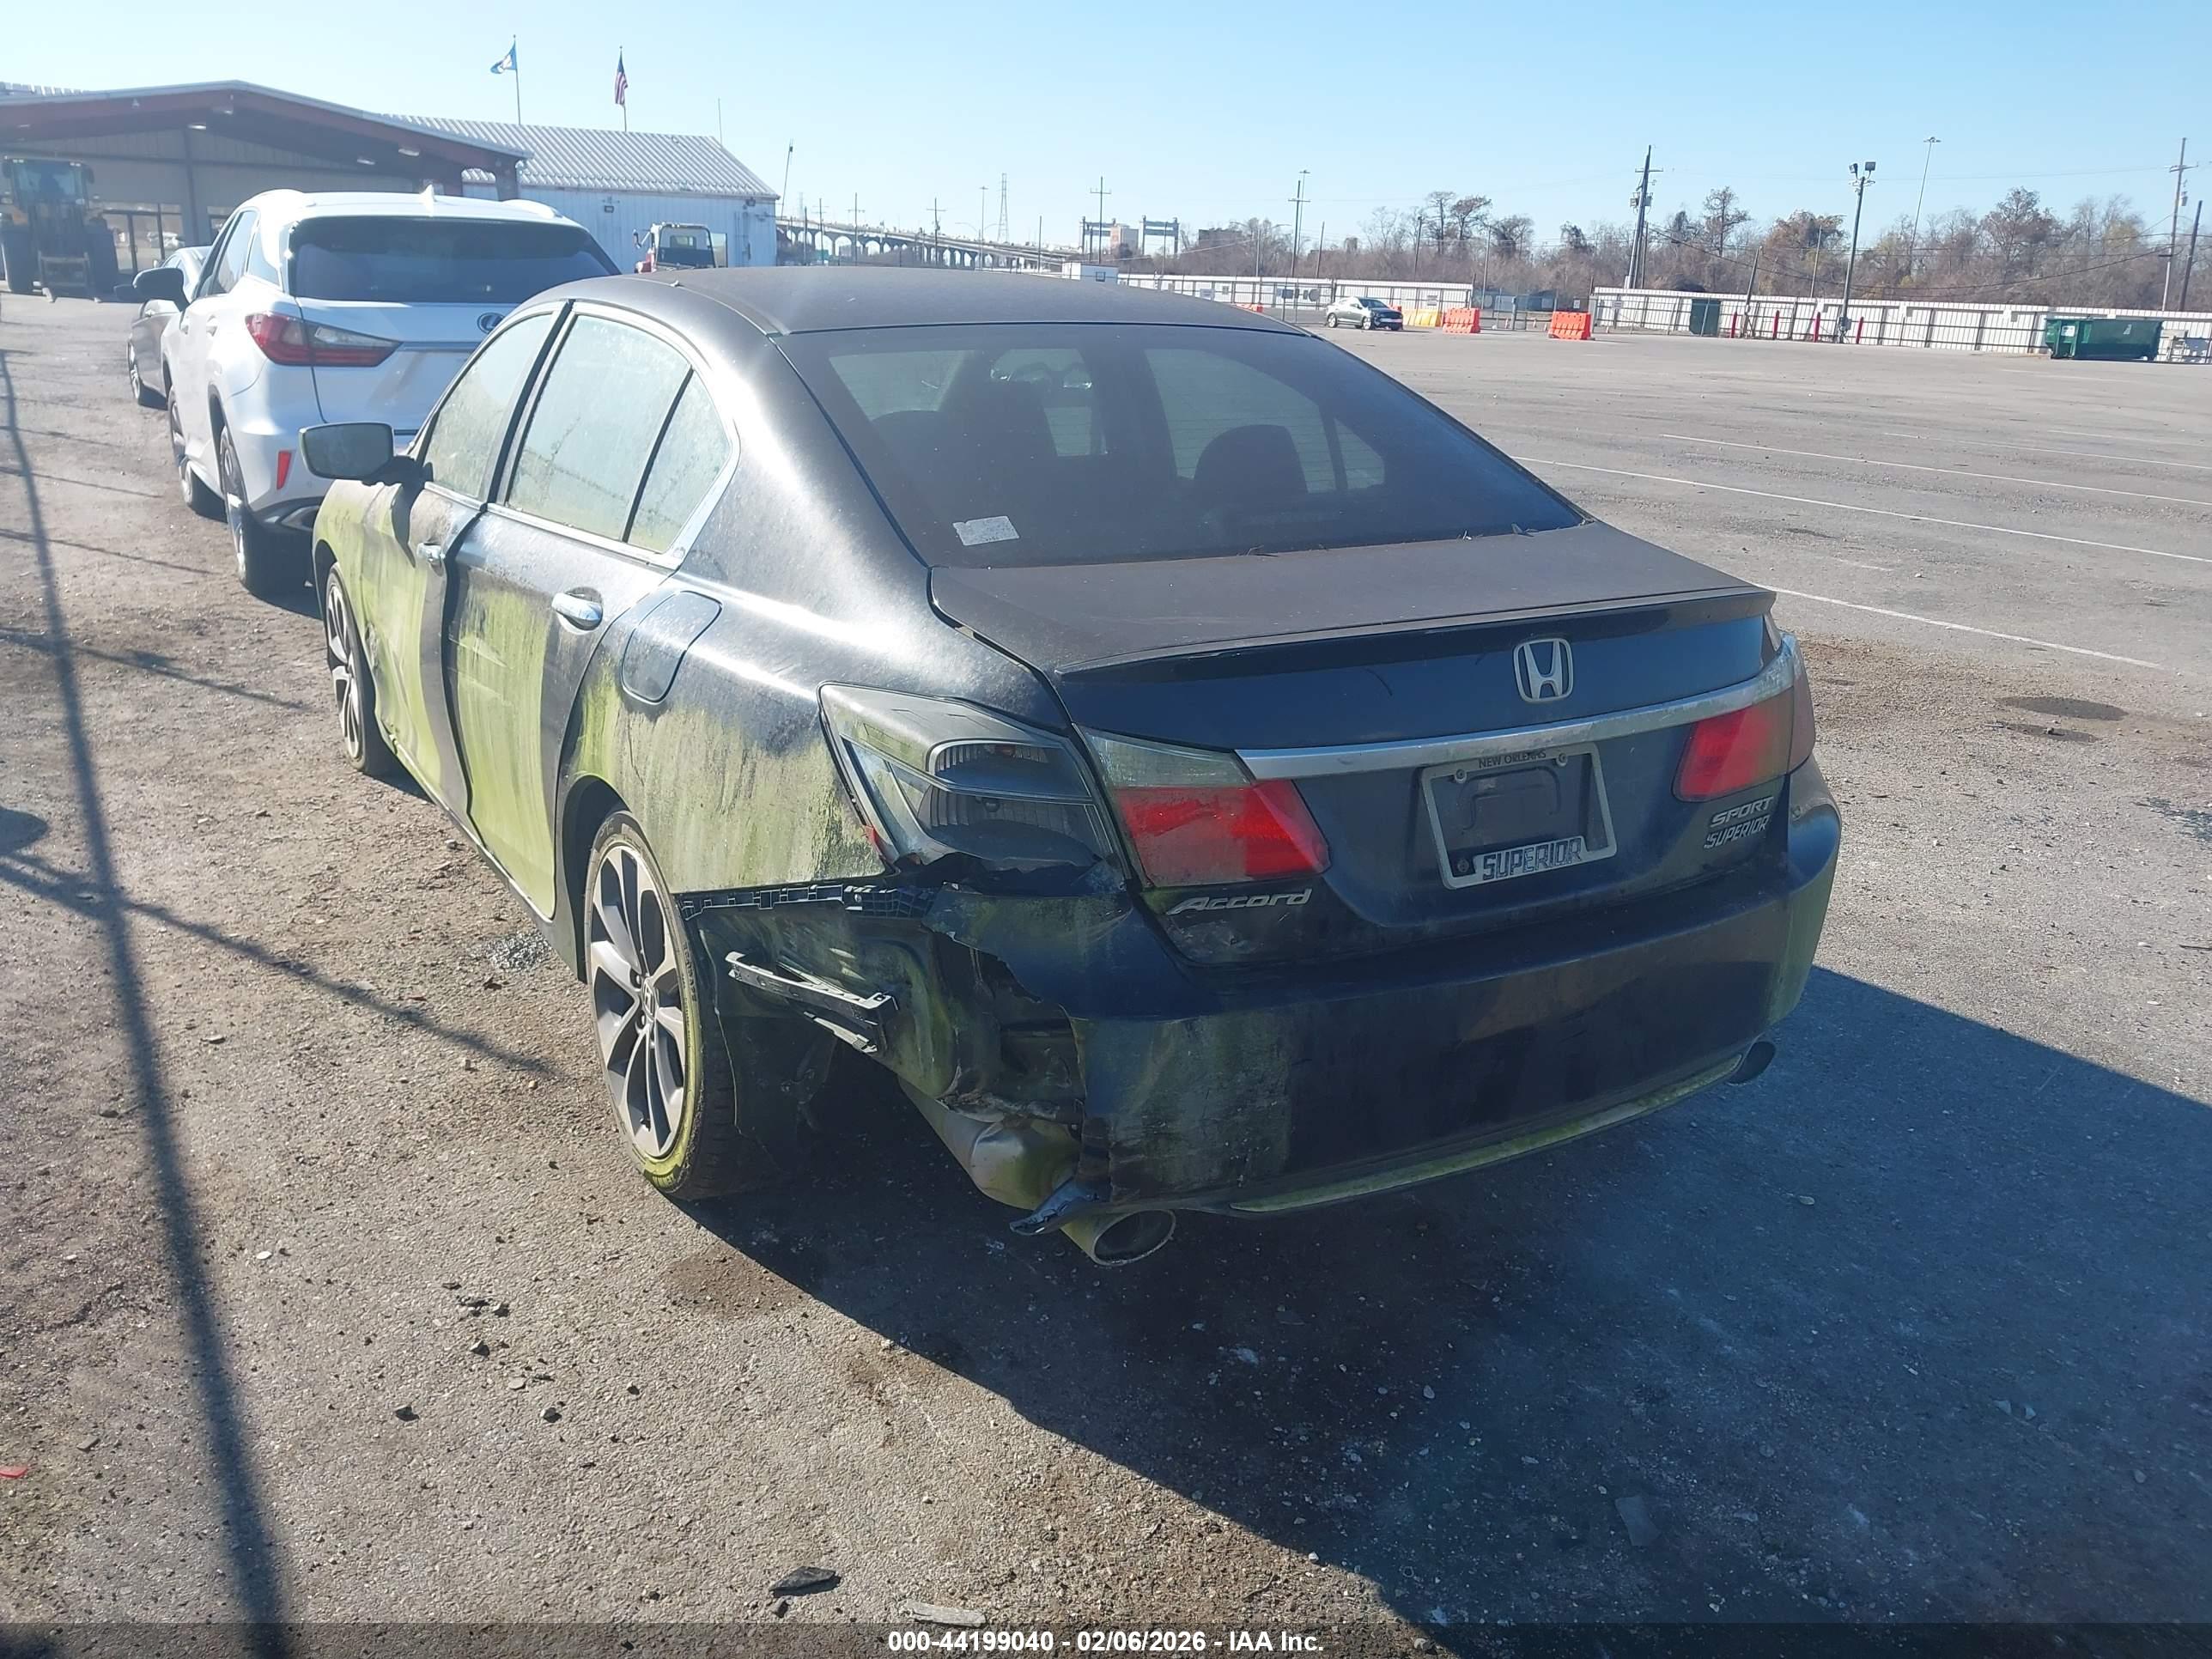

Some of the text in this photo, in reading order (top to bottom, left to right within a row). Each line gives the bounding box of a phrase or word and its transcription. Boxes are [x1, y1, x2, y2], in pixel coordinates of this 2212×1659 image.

[1479, 756, 1501, 769] NEW
[1710, 796, 1774, 828] SPORT
[1704, 815, 1771, 848] SUPERIOR
[1482, 837, 1582, 881] SUPERIOR
[1165, 888, 1313, 915] Accord
